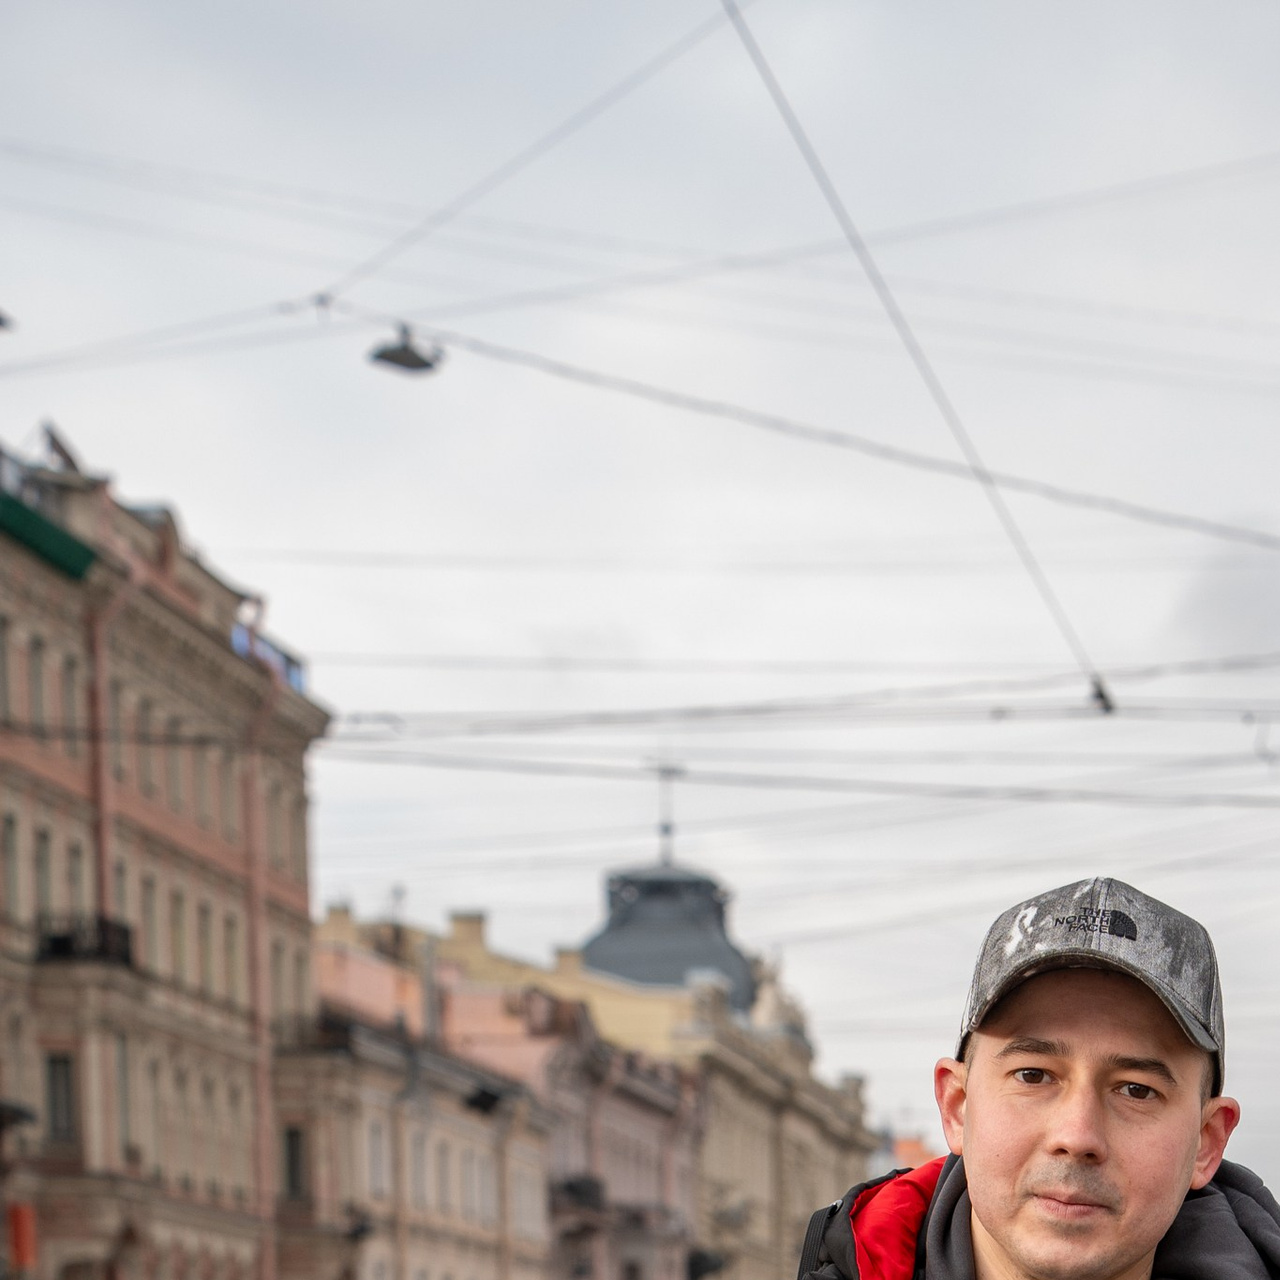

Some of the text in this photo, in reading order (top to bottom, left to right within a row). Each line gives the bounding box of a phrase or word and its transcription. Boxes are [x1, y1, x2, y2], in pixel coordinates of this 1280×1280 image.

[1080, 907, 1111, 917] THE
[1055, 915, 1109, 926] NORTH
[1069, 924, 1108, 933] FACE
